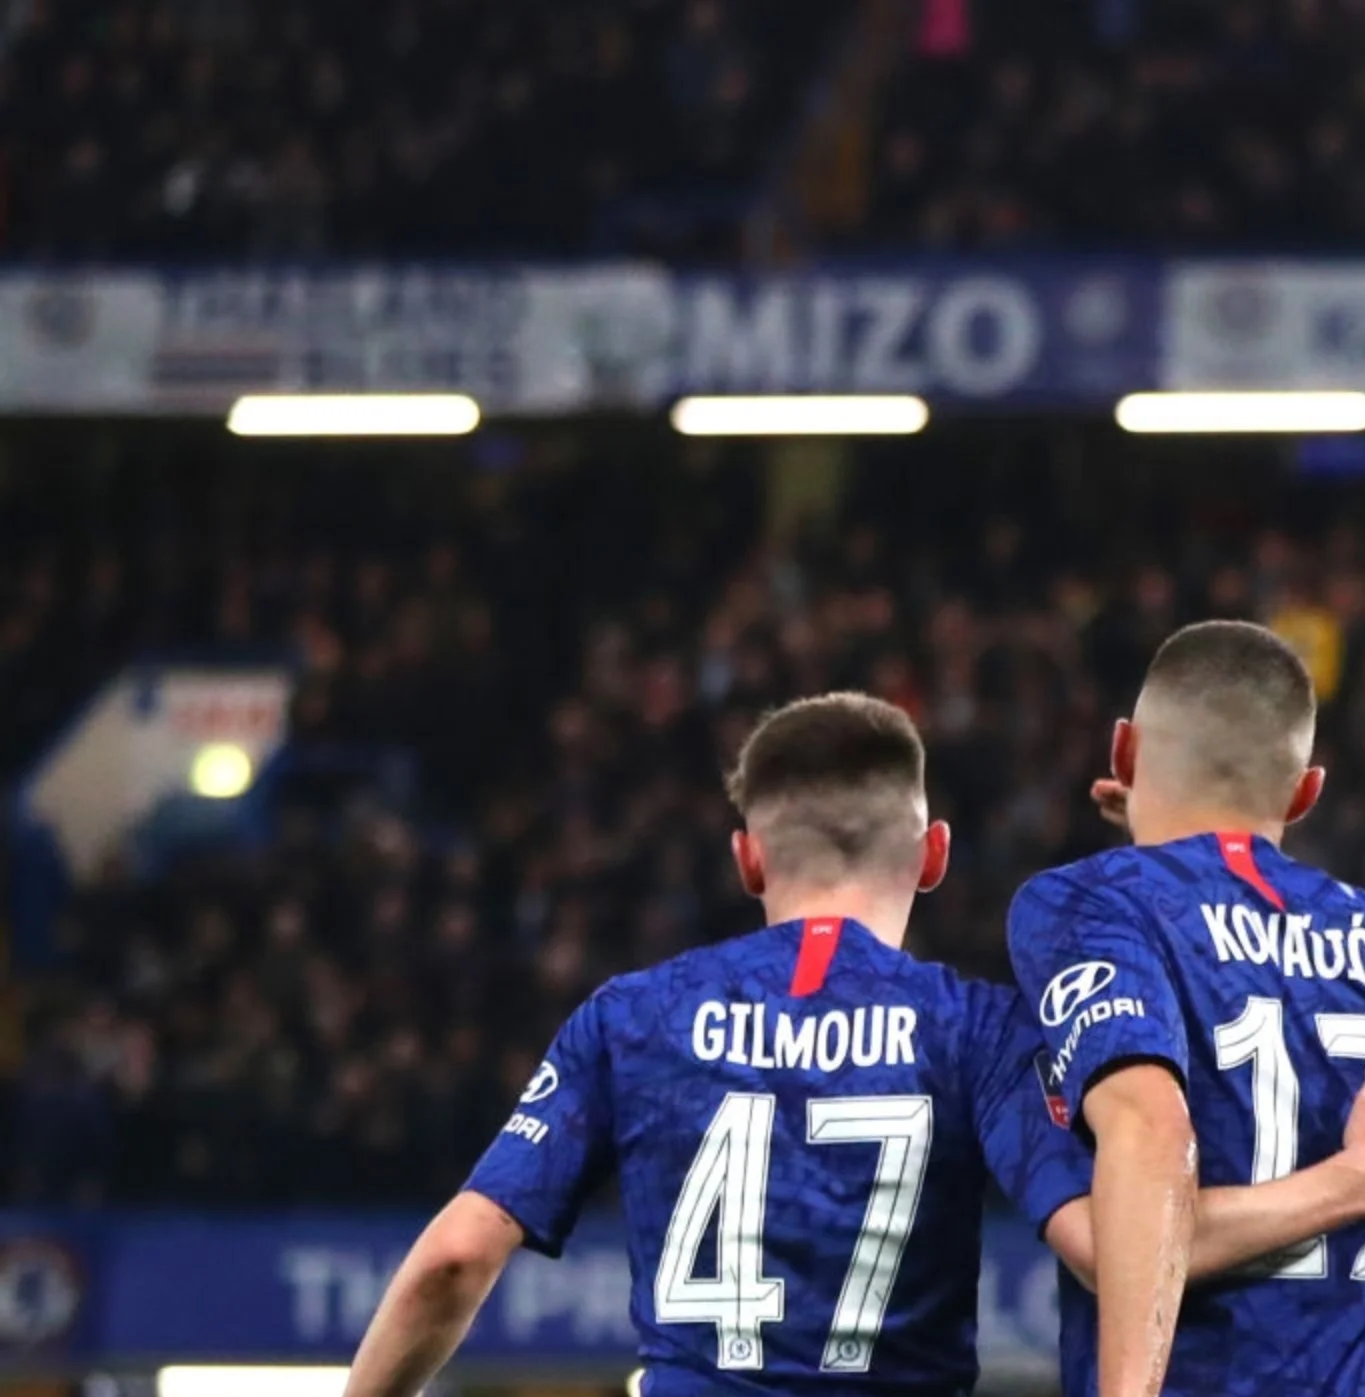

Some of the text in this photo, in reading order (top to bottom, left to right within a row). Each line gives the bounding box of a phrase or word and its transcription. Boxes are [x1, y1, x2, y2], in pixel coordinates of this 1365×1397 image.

[686, 276, 1042, 394] MIZO
[692, 1000, 917, 1073] GILMOUR
[653, 1091, 934, 1373] 47
